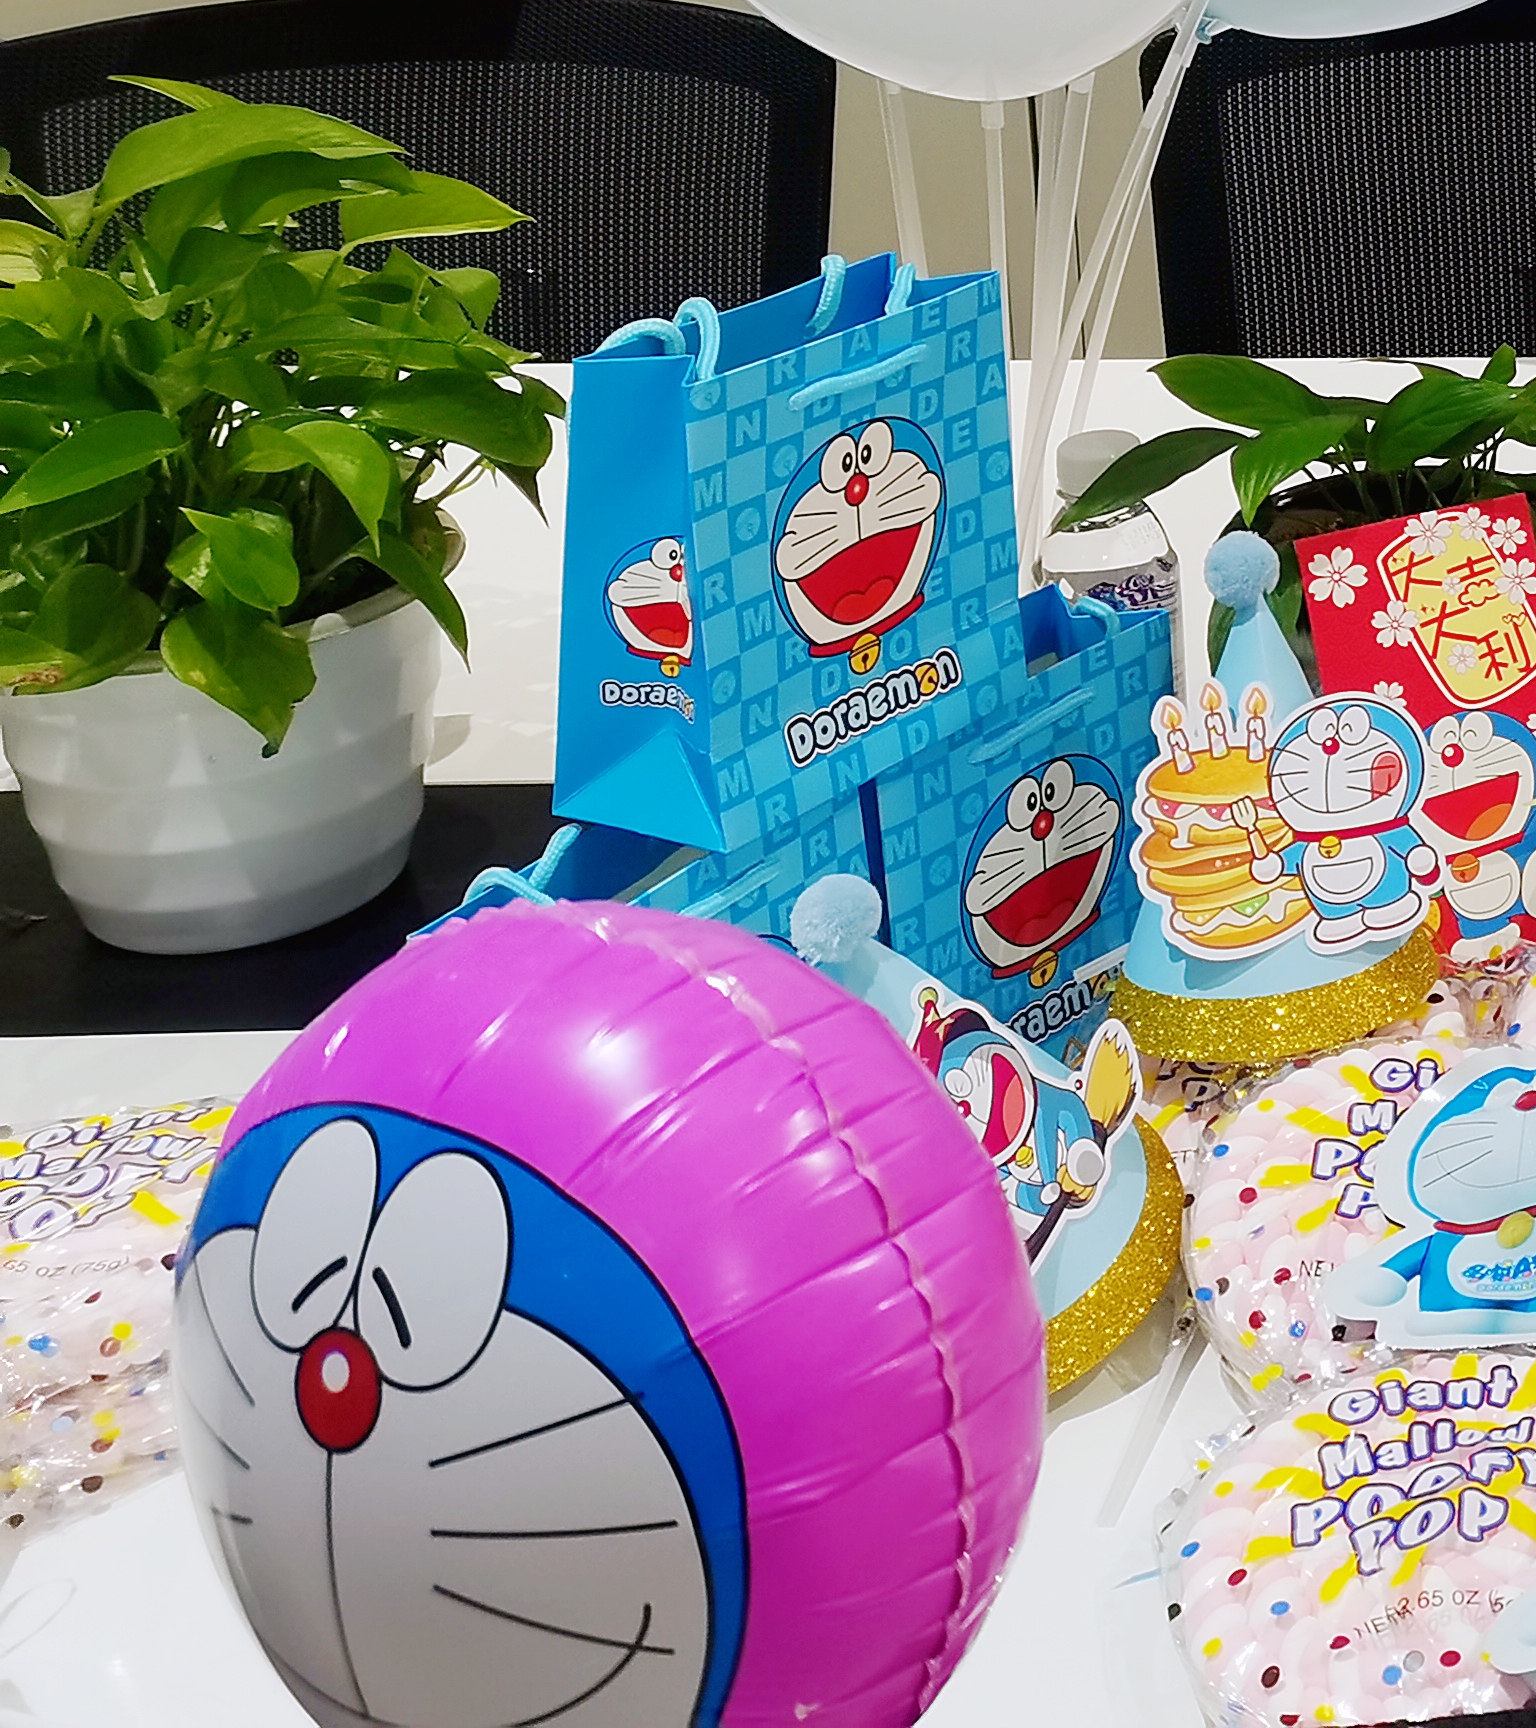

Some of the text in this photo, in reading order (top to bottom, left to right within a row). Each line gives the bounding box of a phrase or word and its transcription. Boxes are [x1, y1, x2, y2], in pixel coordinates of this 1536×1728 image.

[785, 647, 962, 767] Doraemon
[1326, 1365, 1517, 1427] Giant
[1317, 1416, 1534, 1489] Mallow
[1350, 1494, 1509, 1577] POP
[1452, 1589, 1481, 1607] OZ
